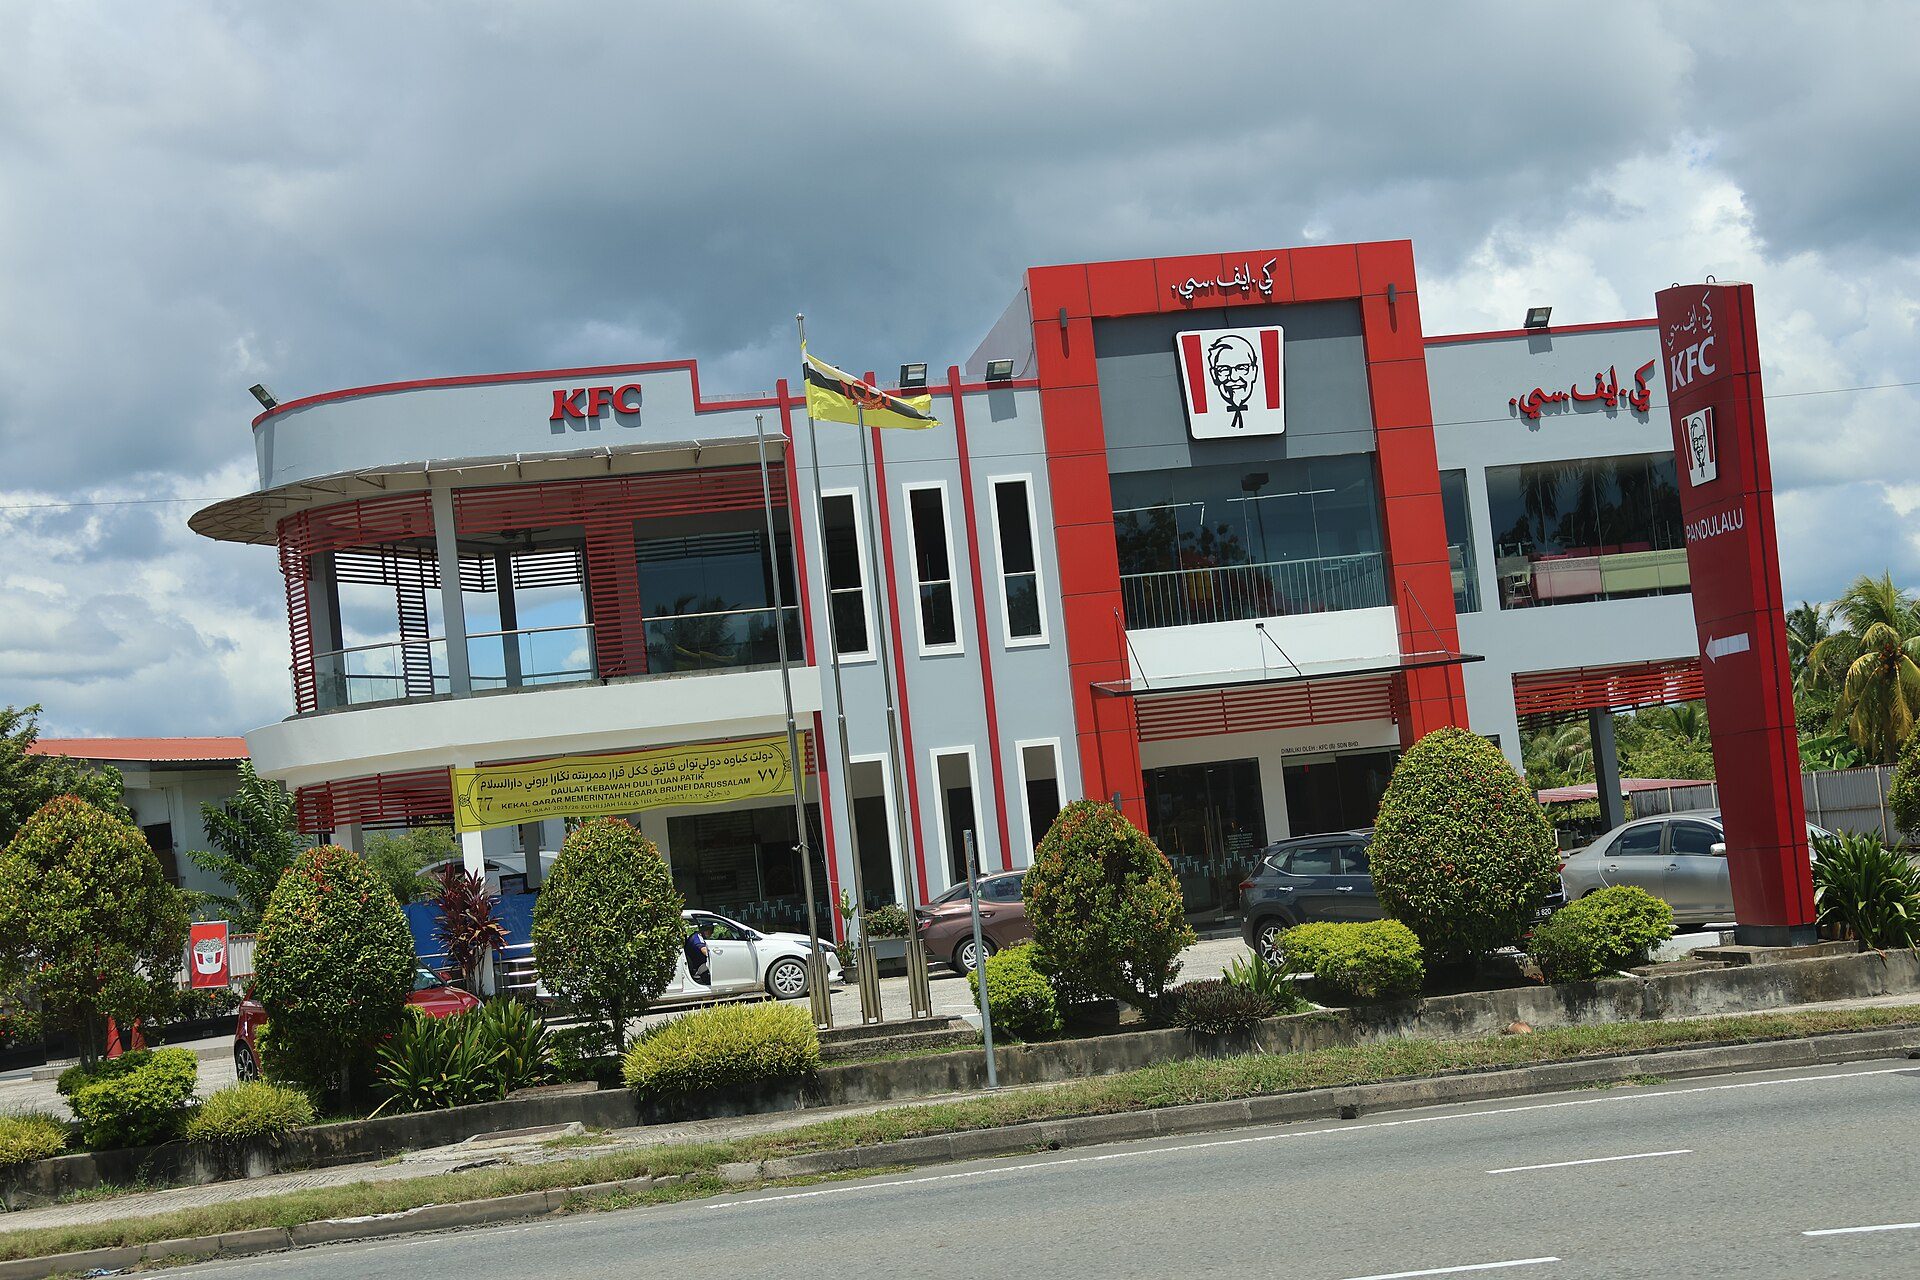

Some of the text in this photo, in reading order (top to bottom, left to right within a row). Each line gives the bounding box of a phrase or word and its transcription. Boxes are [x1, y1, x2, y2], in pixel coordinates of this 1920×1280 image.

[1670, 335, 1716, 393] KFC
[549, 383, 642, 421] KFC
[1685, 508, 1744, 544] PANDULALU
[749, 751, 774, 763] دولت
[551, 773, 705, 796] DAULAT KEBAWAH DULI TUAN PATIK
[757, 767, 778, 782] ٧٧
[476, 796, 494, 812] 77
[501, 777, 751, 811] KEKAL QARAR MEMERINTAH NEGARA BRUNEI DARUSSALAM
